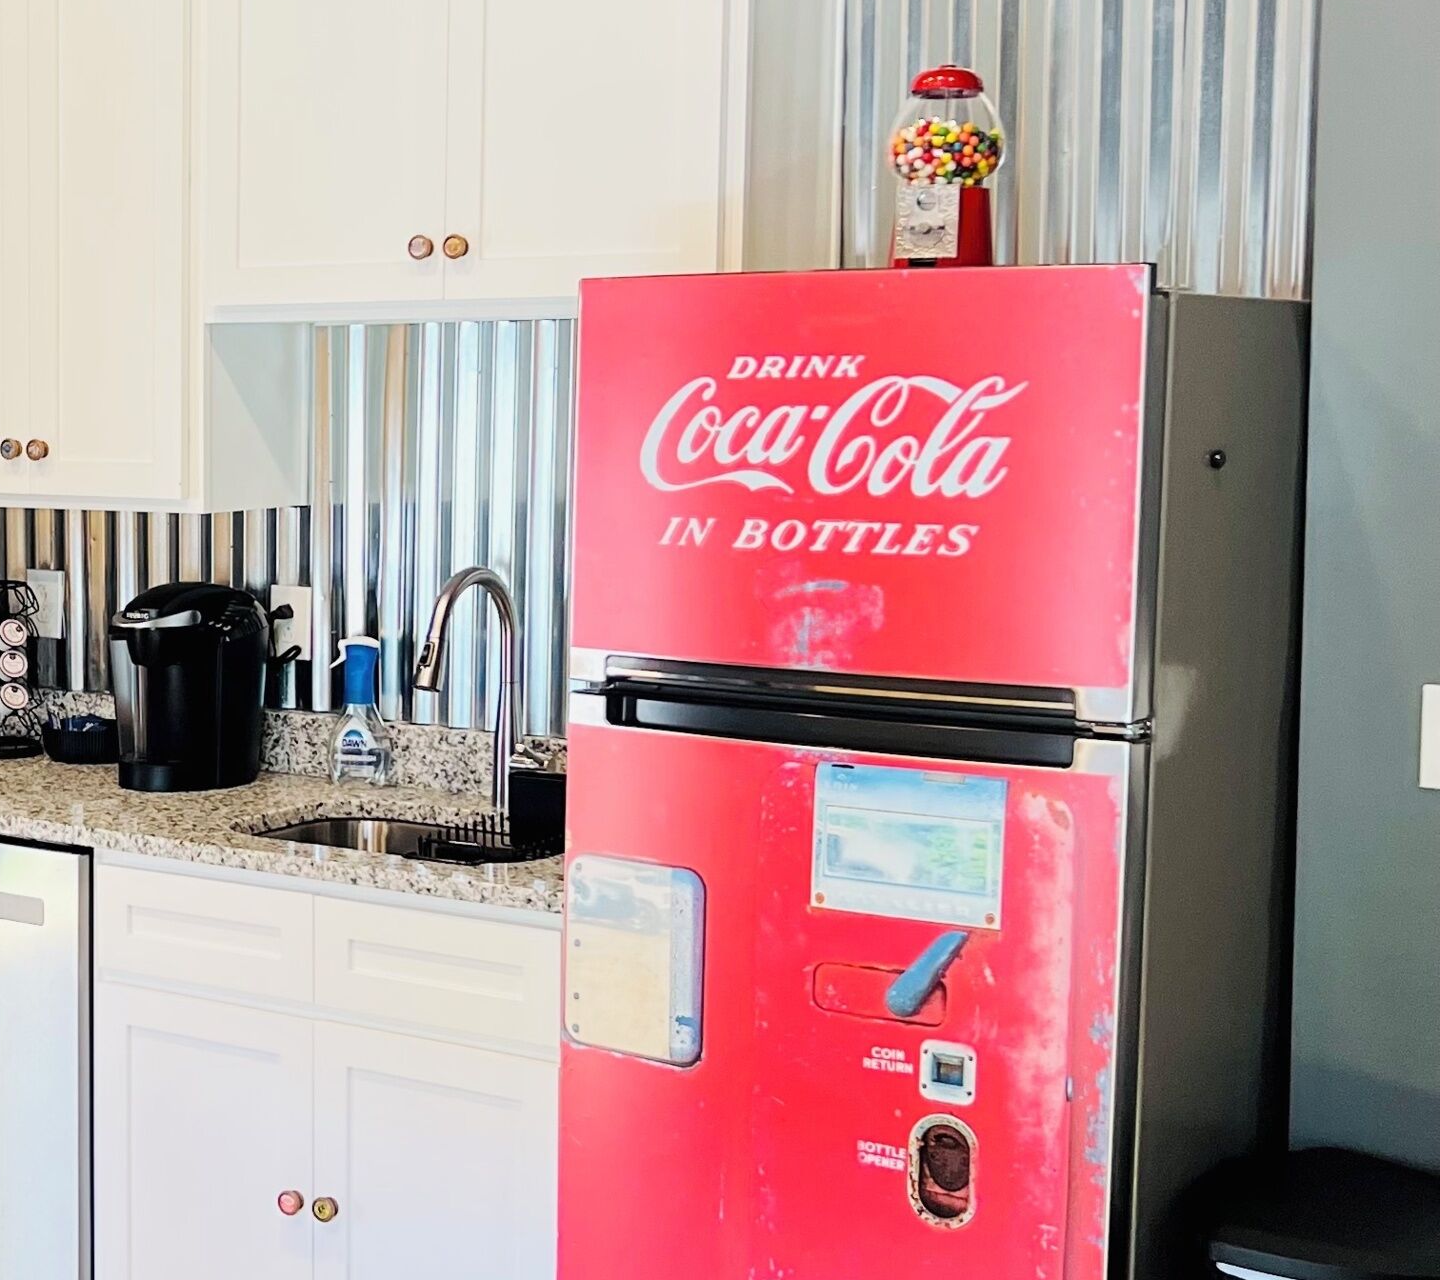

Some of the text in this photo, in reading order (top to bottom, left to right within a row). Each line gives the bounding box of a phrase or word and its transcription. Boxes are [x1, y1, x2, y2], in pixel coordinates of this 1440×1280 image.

[727, 354, 866, 381] DRINK
[640, 375, 1029, 499] Coca-Cola
[660, 517, 979, 557] IN BOTTLES
[341, 738, 367, 748] DAWN
[871, 1046, 905, 1060] COIN
[862, 1057, 913, 1074] RETURN
[857, 1140, 906, 1159] BOTTLE
[858, 1151, 906, 1171] OPENER
